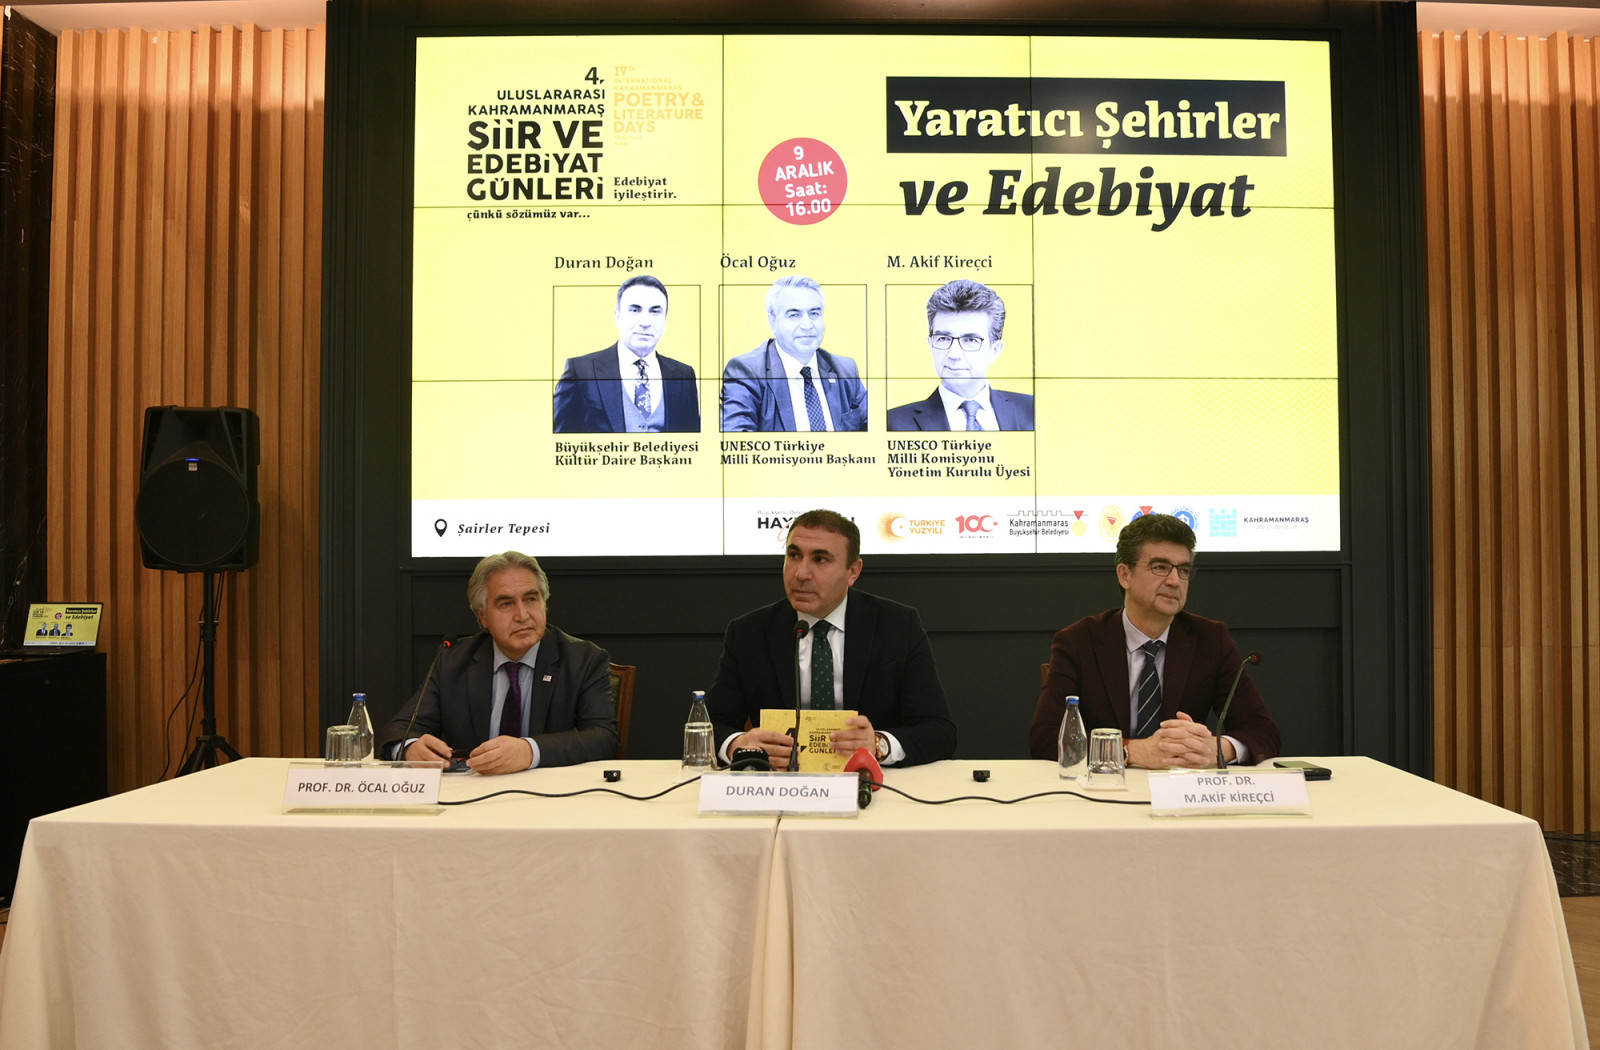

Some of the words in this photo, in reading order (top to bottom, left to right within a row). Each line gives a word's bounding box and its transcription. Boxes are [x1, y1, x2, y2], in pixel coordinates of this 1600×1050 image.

[497, 89, 605, 100] ULUSLARARASI
[614, 92, 690, 107] POETRY
[691, 92, 704, 107] &
[468, 104, 605, 118] KAHRAMANMARAŞ
[614, 108, 704, 120] LITERATURE
[614, 121, 656, 134] DAYS
[894, 99, 1084, 138] Yaratıcı
[1095, 99, 1281, 150] Şehirler
[552, 120, 604, 148] VE
[794, 146, 804, 160] 9
[776, 160, 834, 182] ARALIK
[614, 176, 668, 188] Edebiyat
[614, 188, 678, 202] iyileştirir.
[784, 182, 828, 198] Saat:
[899, 179, 969, 217] ve
[982, 166, 1255, 232] Edebiyat
[786, 198, 832, 216] 16.00
[467, 210, 502, 222] çünkü
[506, 210, 557, 219] sözümüz
[560, 210, 590, 218] var...
[554, 256, 600, 269] Duran
[606, 256, 654, 272] Doğan
[720, 253, 753, 268] Öcal
[758, 256, 796, 272] Oğuz
[886, 255, 906, 268] M.
[909, 254, 940, 268] Akif
[943, 254, 993, 272] Kireçci
[555, 441, 630, 456] Büyükşehir
[633, 441, 699, 455] Belediyesi
[720, 440, 771, 452] UNESCO
[774, 440, 825, 454] Türkiye
[888, 440, 938, 450] UNESCO
[942, 440, 992, 454] Türkiye
[555, 454, 598, 466] Kültür
[602, 454, 636, 466] Daire
[640, 454, 692, 468] Başkanı
[720, 454, 748, 464] Milli
[752, 454, 822, 467] Komisyonu
[826, 454, 876, 467] Başkanı
[888, 453, 918, 464] Milli
[921, 453, 995, 466] Komisyonu
[888, 467, 942, 478] Yönetim
[946, 466, 992, 477] Kurulu
[996, 464, 1030, 480] Üyesi
[457, 522, 504, 537] Şairler
[508, 522, 550, 536] Tepesi
[1010, 518, 1068, 528] Kahramanmaraş
[298, 782, 331, 792] PROF.
[335, 782, 354, 792] DR.
[358, 780, 388, 793] ÖCAL
[392, 780, 426, 794] OĞUZ
[1197, 776, 1232, 786] PROF.
[1235, 776, 1256, 786] DR.
[726, 786, 774, 796] DURAN
[779, 784, 830, 798] DOĞAN
[1230, 791, 1275, 804] KİREÇCİ
